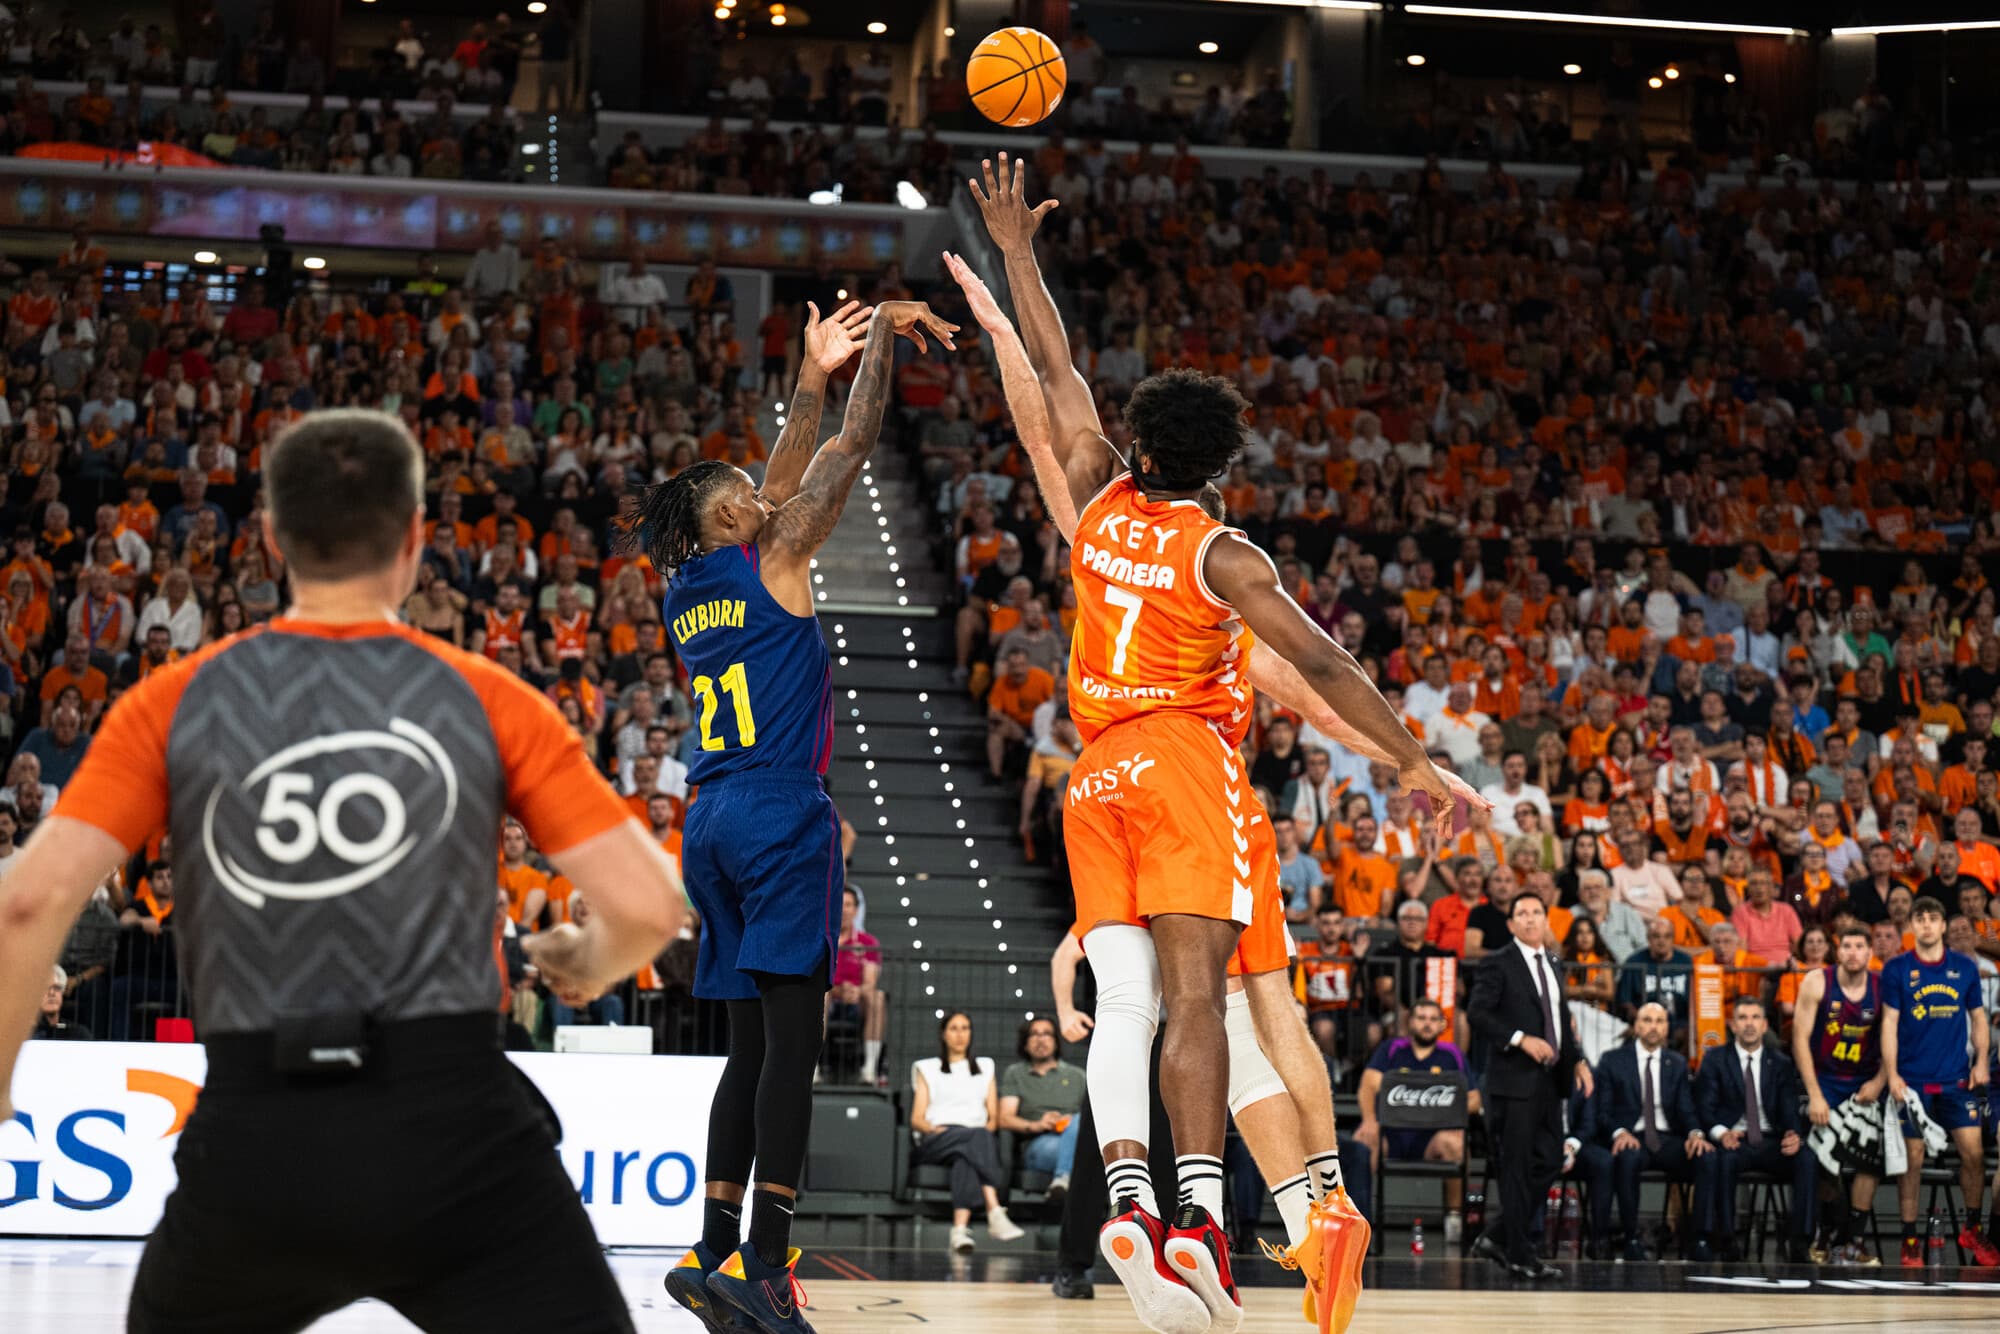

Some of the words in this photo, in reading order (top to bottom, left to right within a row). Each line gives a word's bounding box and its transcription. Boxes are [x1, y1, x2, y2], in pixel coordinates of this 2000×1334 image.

[1096, 512, 1180, 555] KEY
[1081, 542, 1176, 591] PAMESA
[672, 599, 746, 645] CLYBURN
[1104, 583, 1144, 676] 7
[692, 662, 756, 752] 21
[255, 772, 407, 864] 50
[1832, 1041, 1862, 1063] 44
